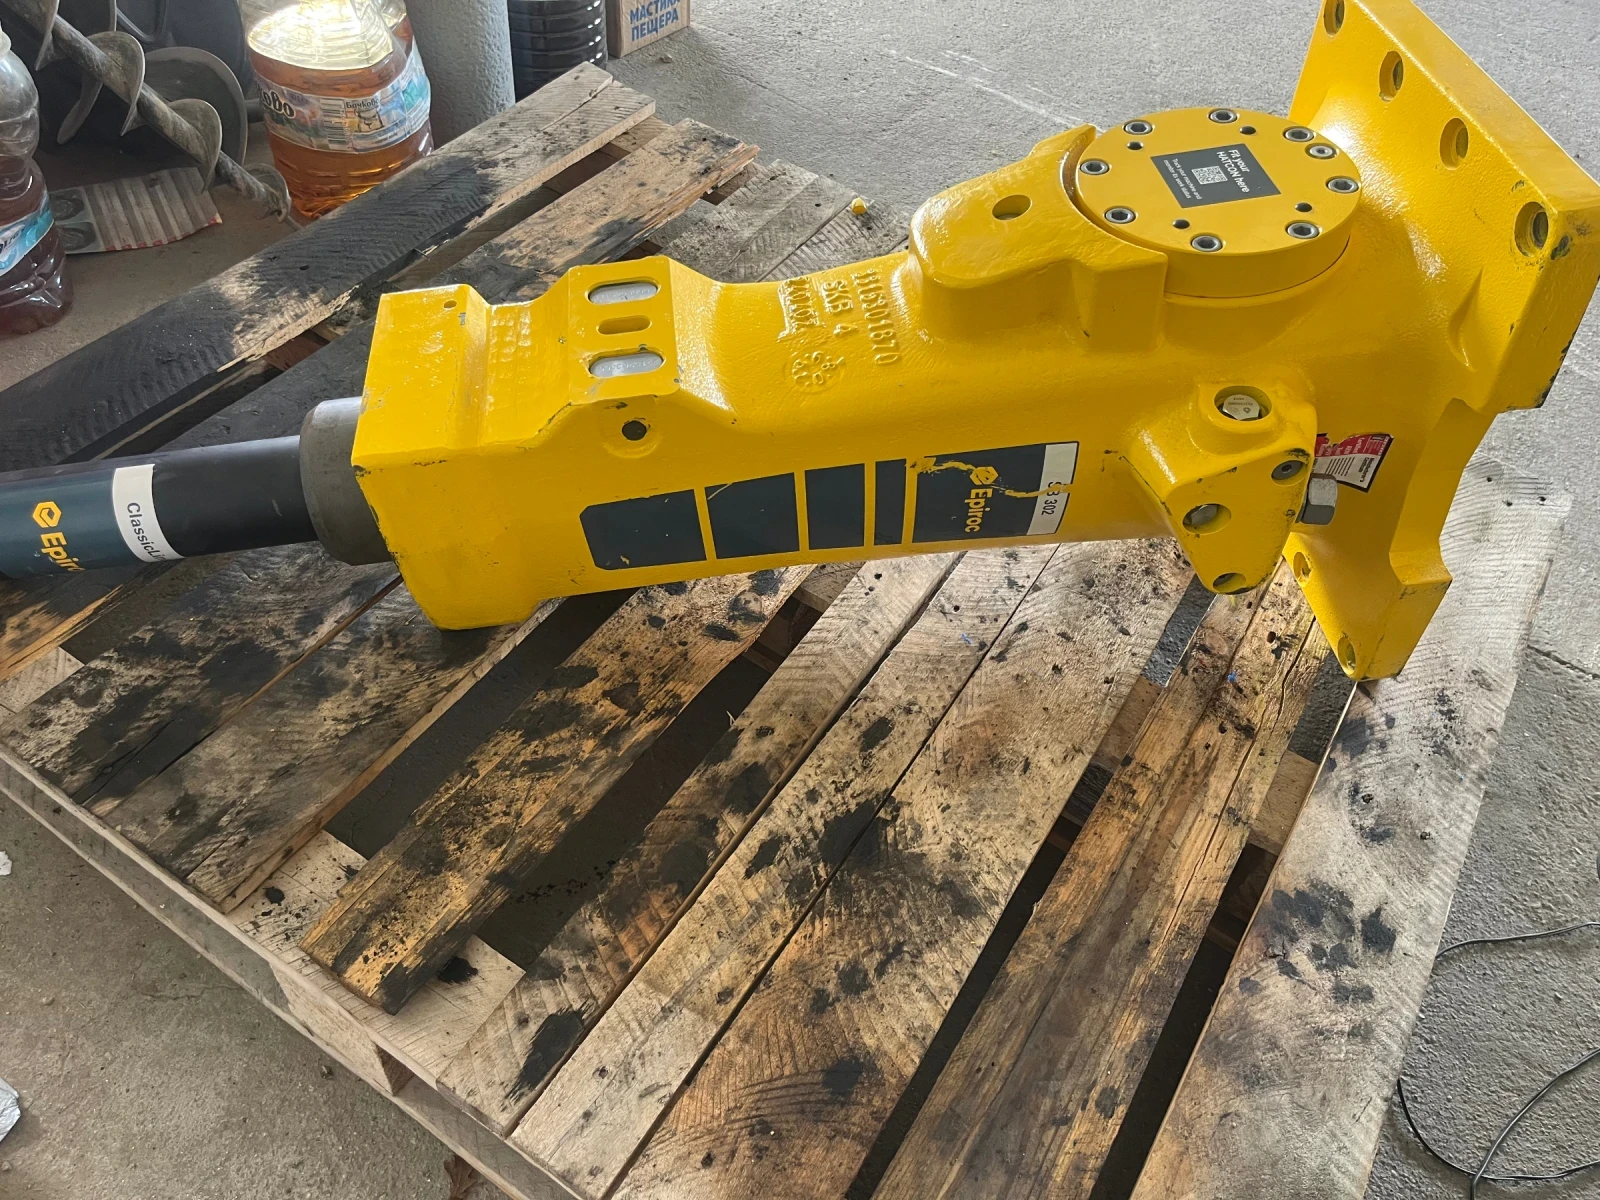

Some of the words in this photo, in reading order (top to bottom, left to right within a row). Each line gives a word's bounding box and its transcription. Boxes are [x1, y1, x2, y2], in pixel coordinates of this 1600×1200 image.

[631, 8, 679, 42] ПЕЩЕРА
[1228, 149, 1240, 159] Fit
[1232, 158, 1250, 173] your
[1216, 151, 1241, 178] HATCON
[1234, 177, 1250, 193] here
[964, 488, 994, 533] Epiroc
[1041, 499, 1058, 516] 302
